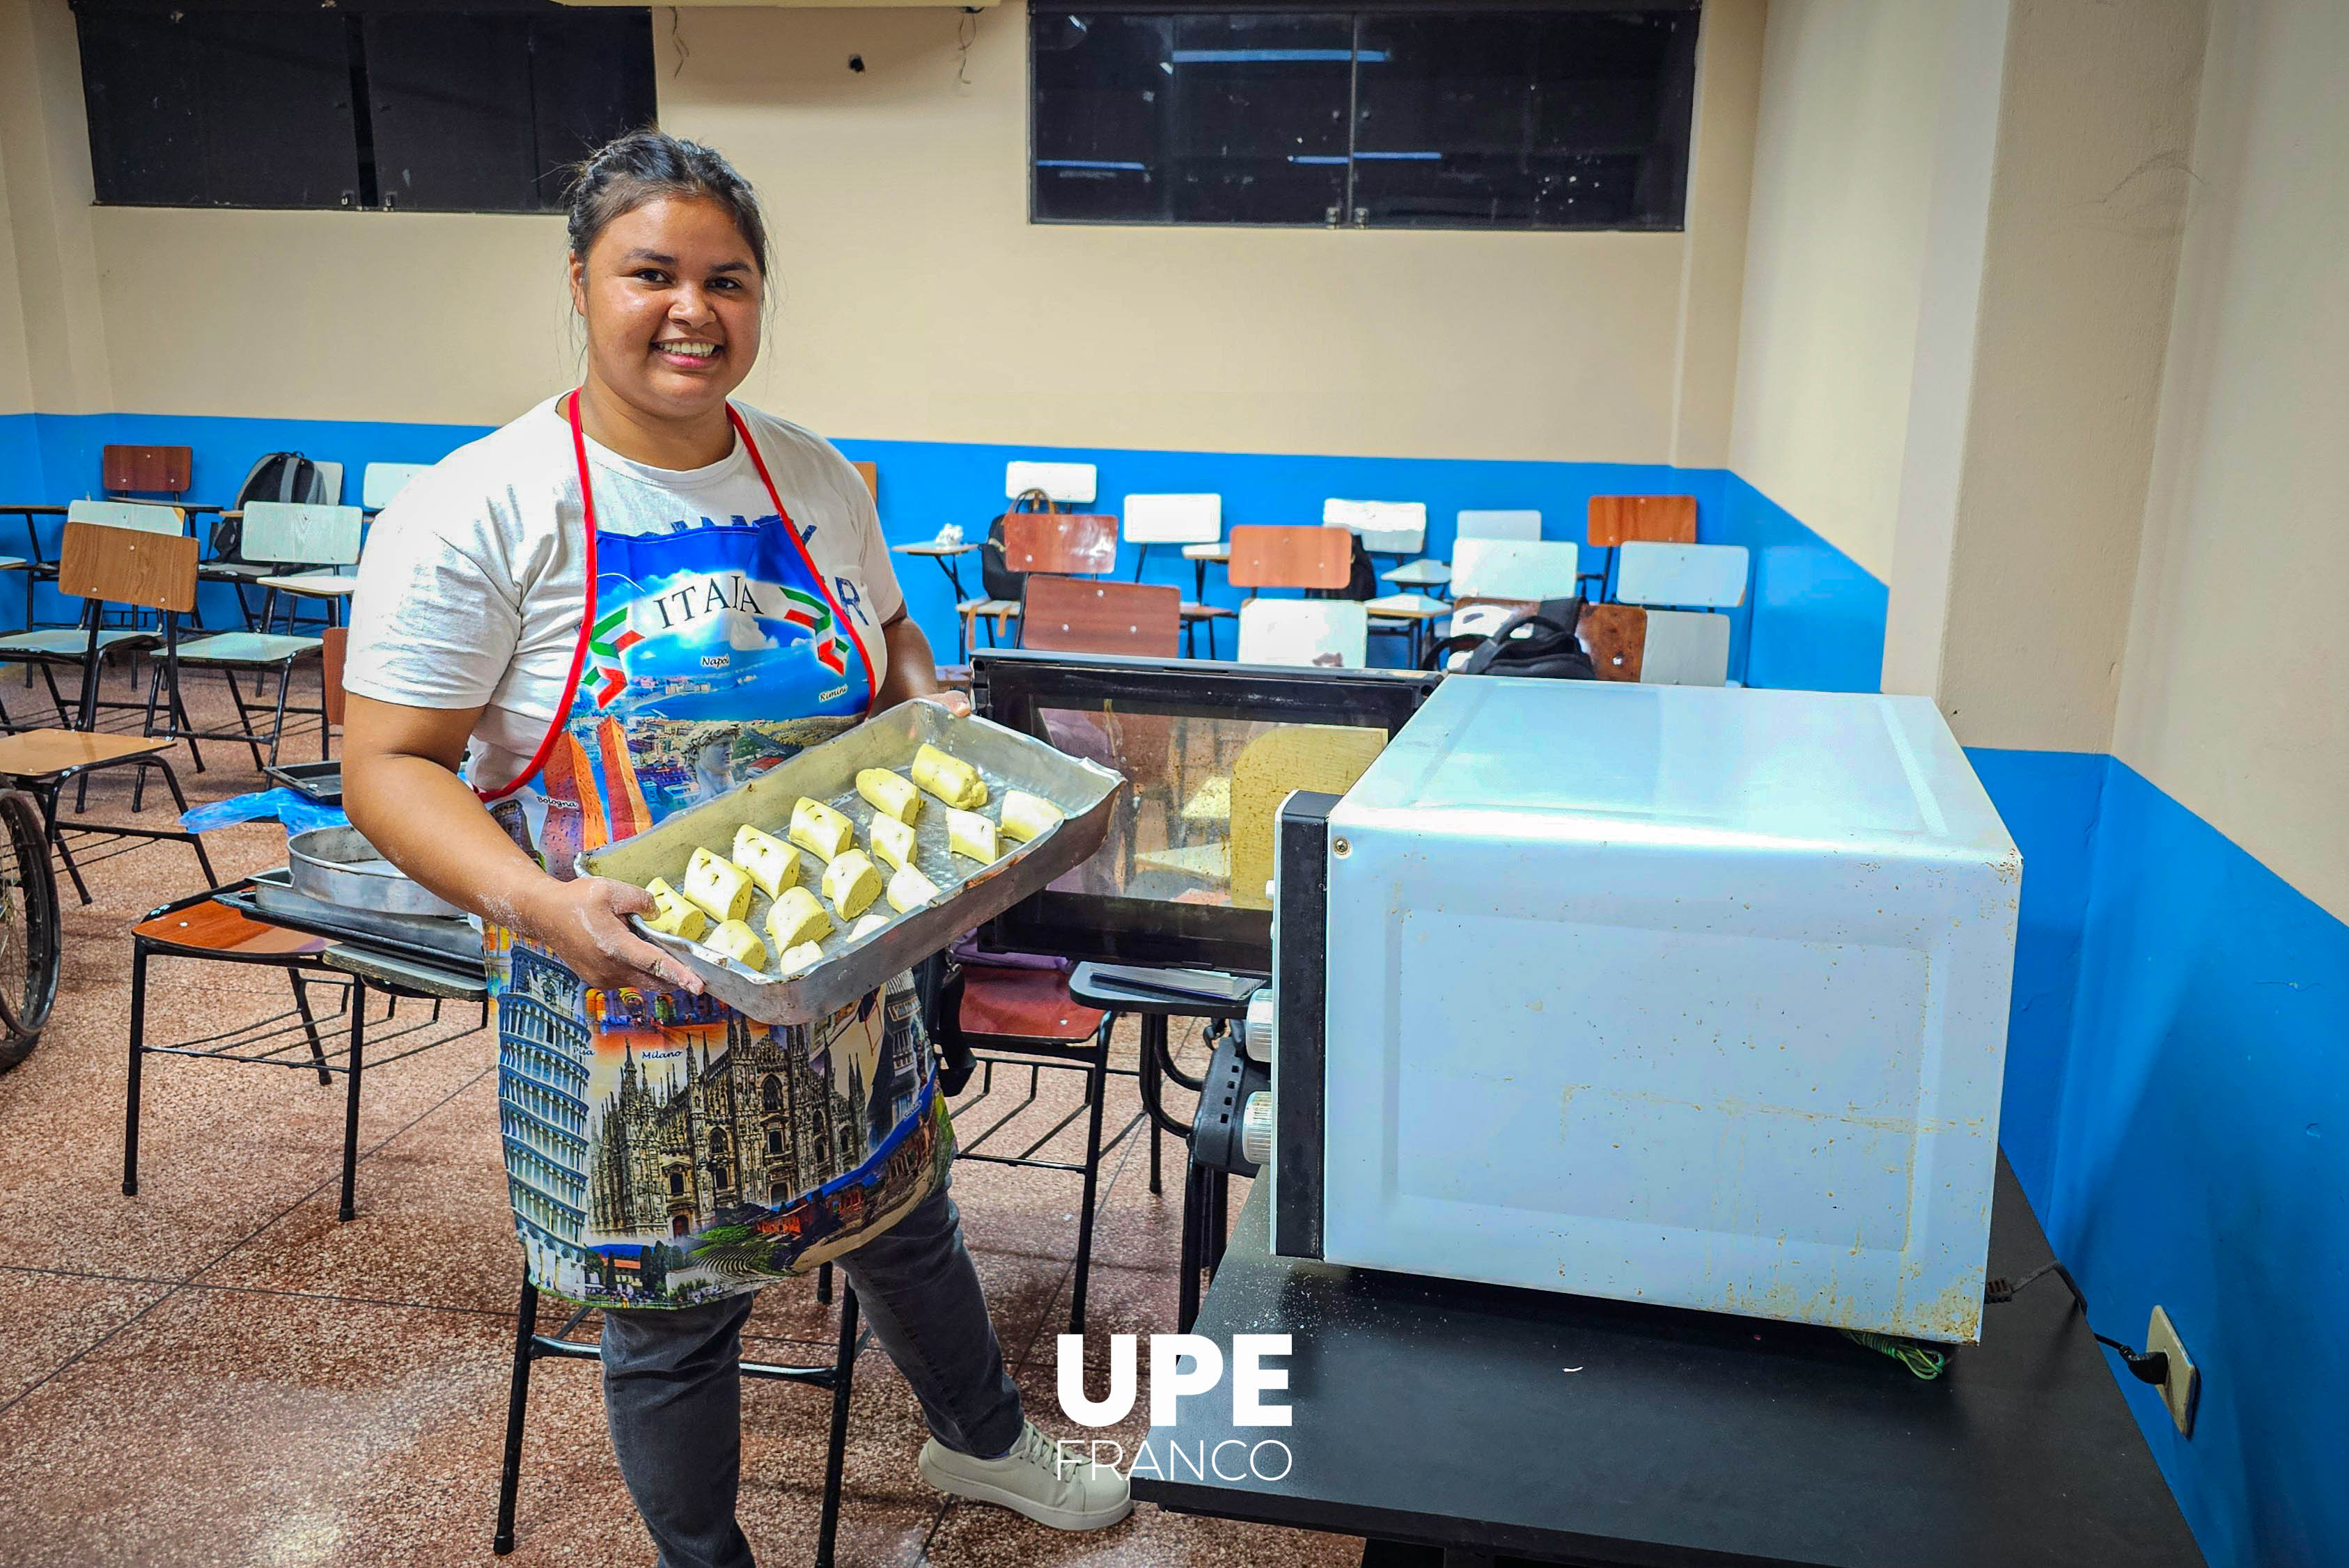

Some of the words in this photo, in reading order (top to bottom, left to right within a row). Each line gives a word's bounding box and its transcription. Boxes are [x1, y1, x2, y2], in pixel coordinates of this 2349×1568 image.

[702, 655, 729, 668] Napol
[820, 685, 848, 702] Rimini
[536, 796, 577, 808] Bologna
[573, 1047, 595, 1056] Pisa
[642, 1050, 682, 1059] Milano
